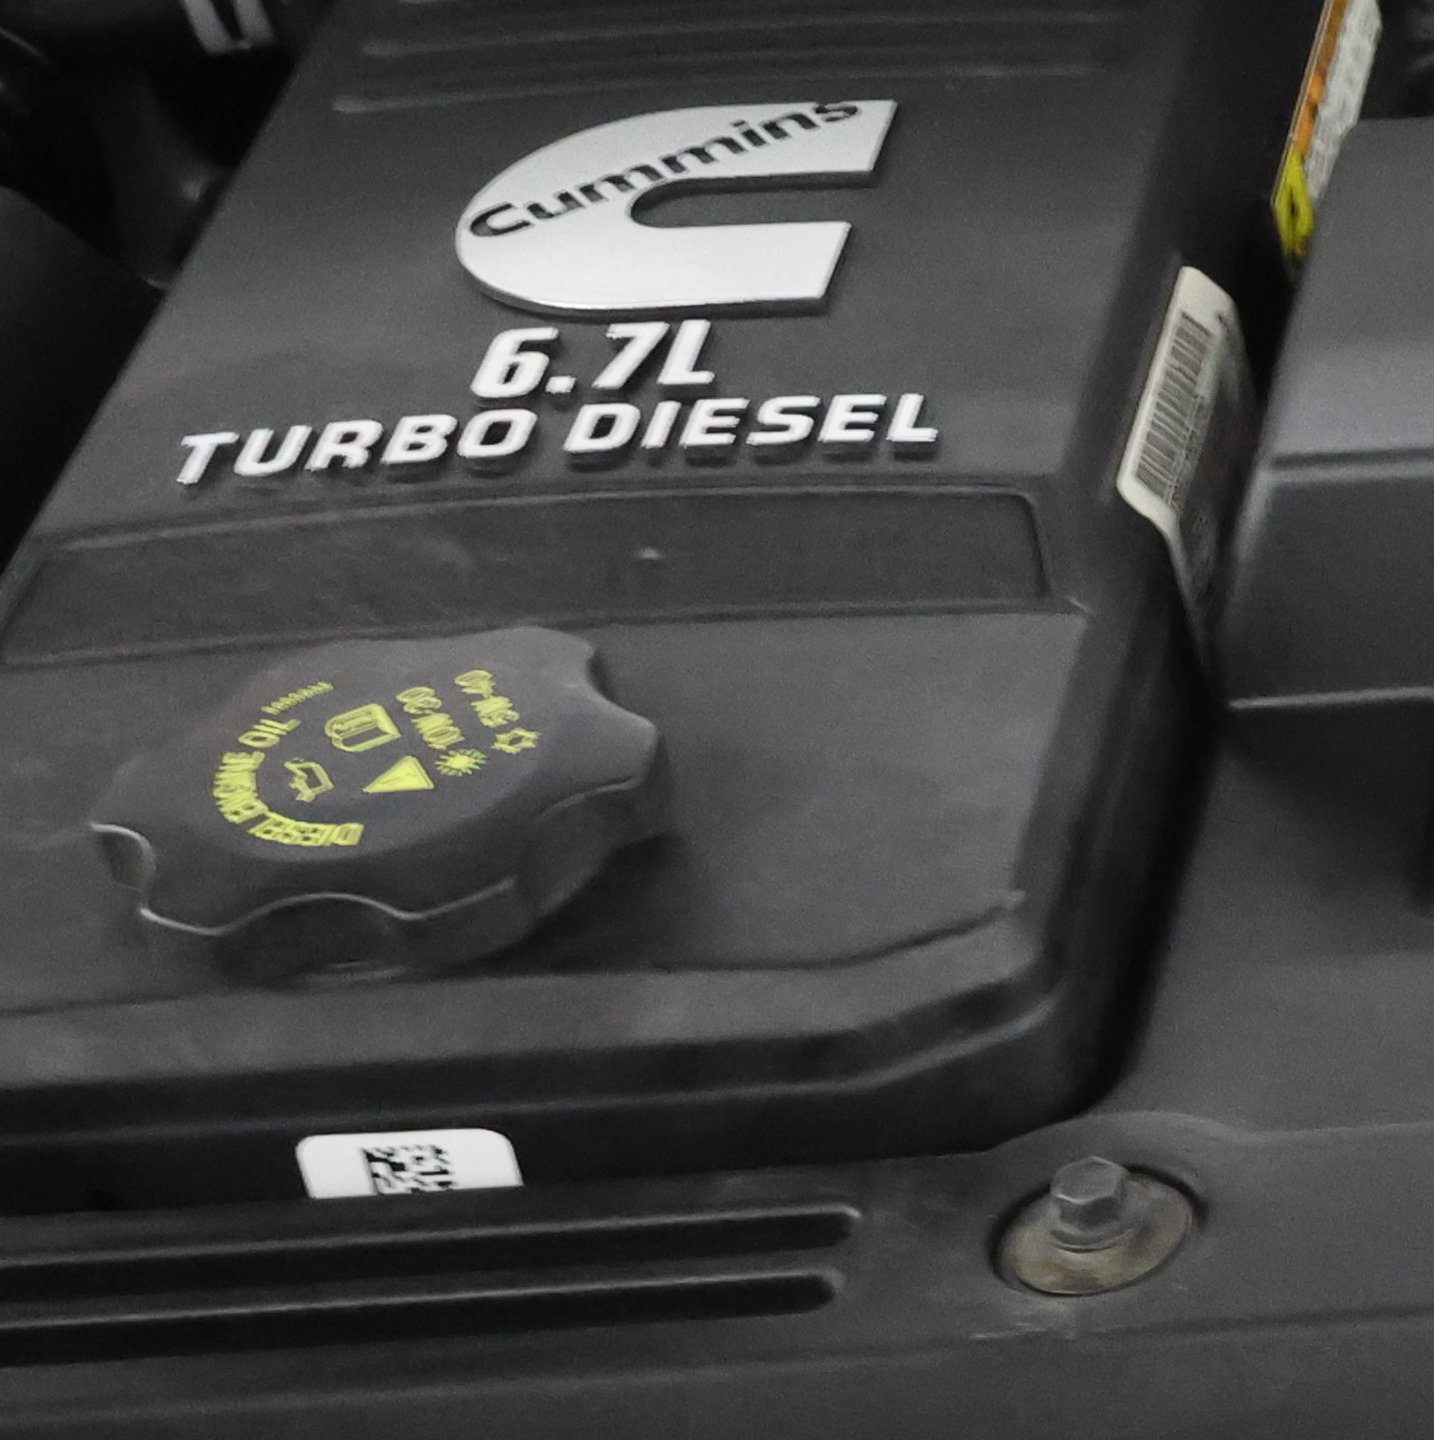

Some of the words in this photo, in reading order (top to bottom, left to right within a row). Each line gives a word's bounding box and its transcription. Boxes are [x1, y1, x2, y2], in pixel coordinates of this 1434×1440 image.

[469, 100, 859, 238] Cummins
[470, 318, 716, 399] 6.7L
[177, 407, 538, 484] TURBO
[562, 392, 938, 454] DIESEL
